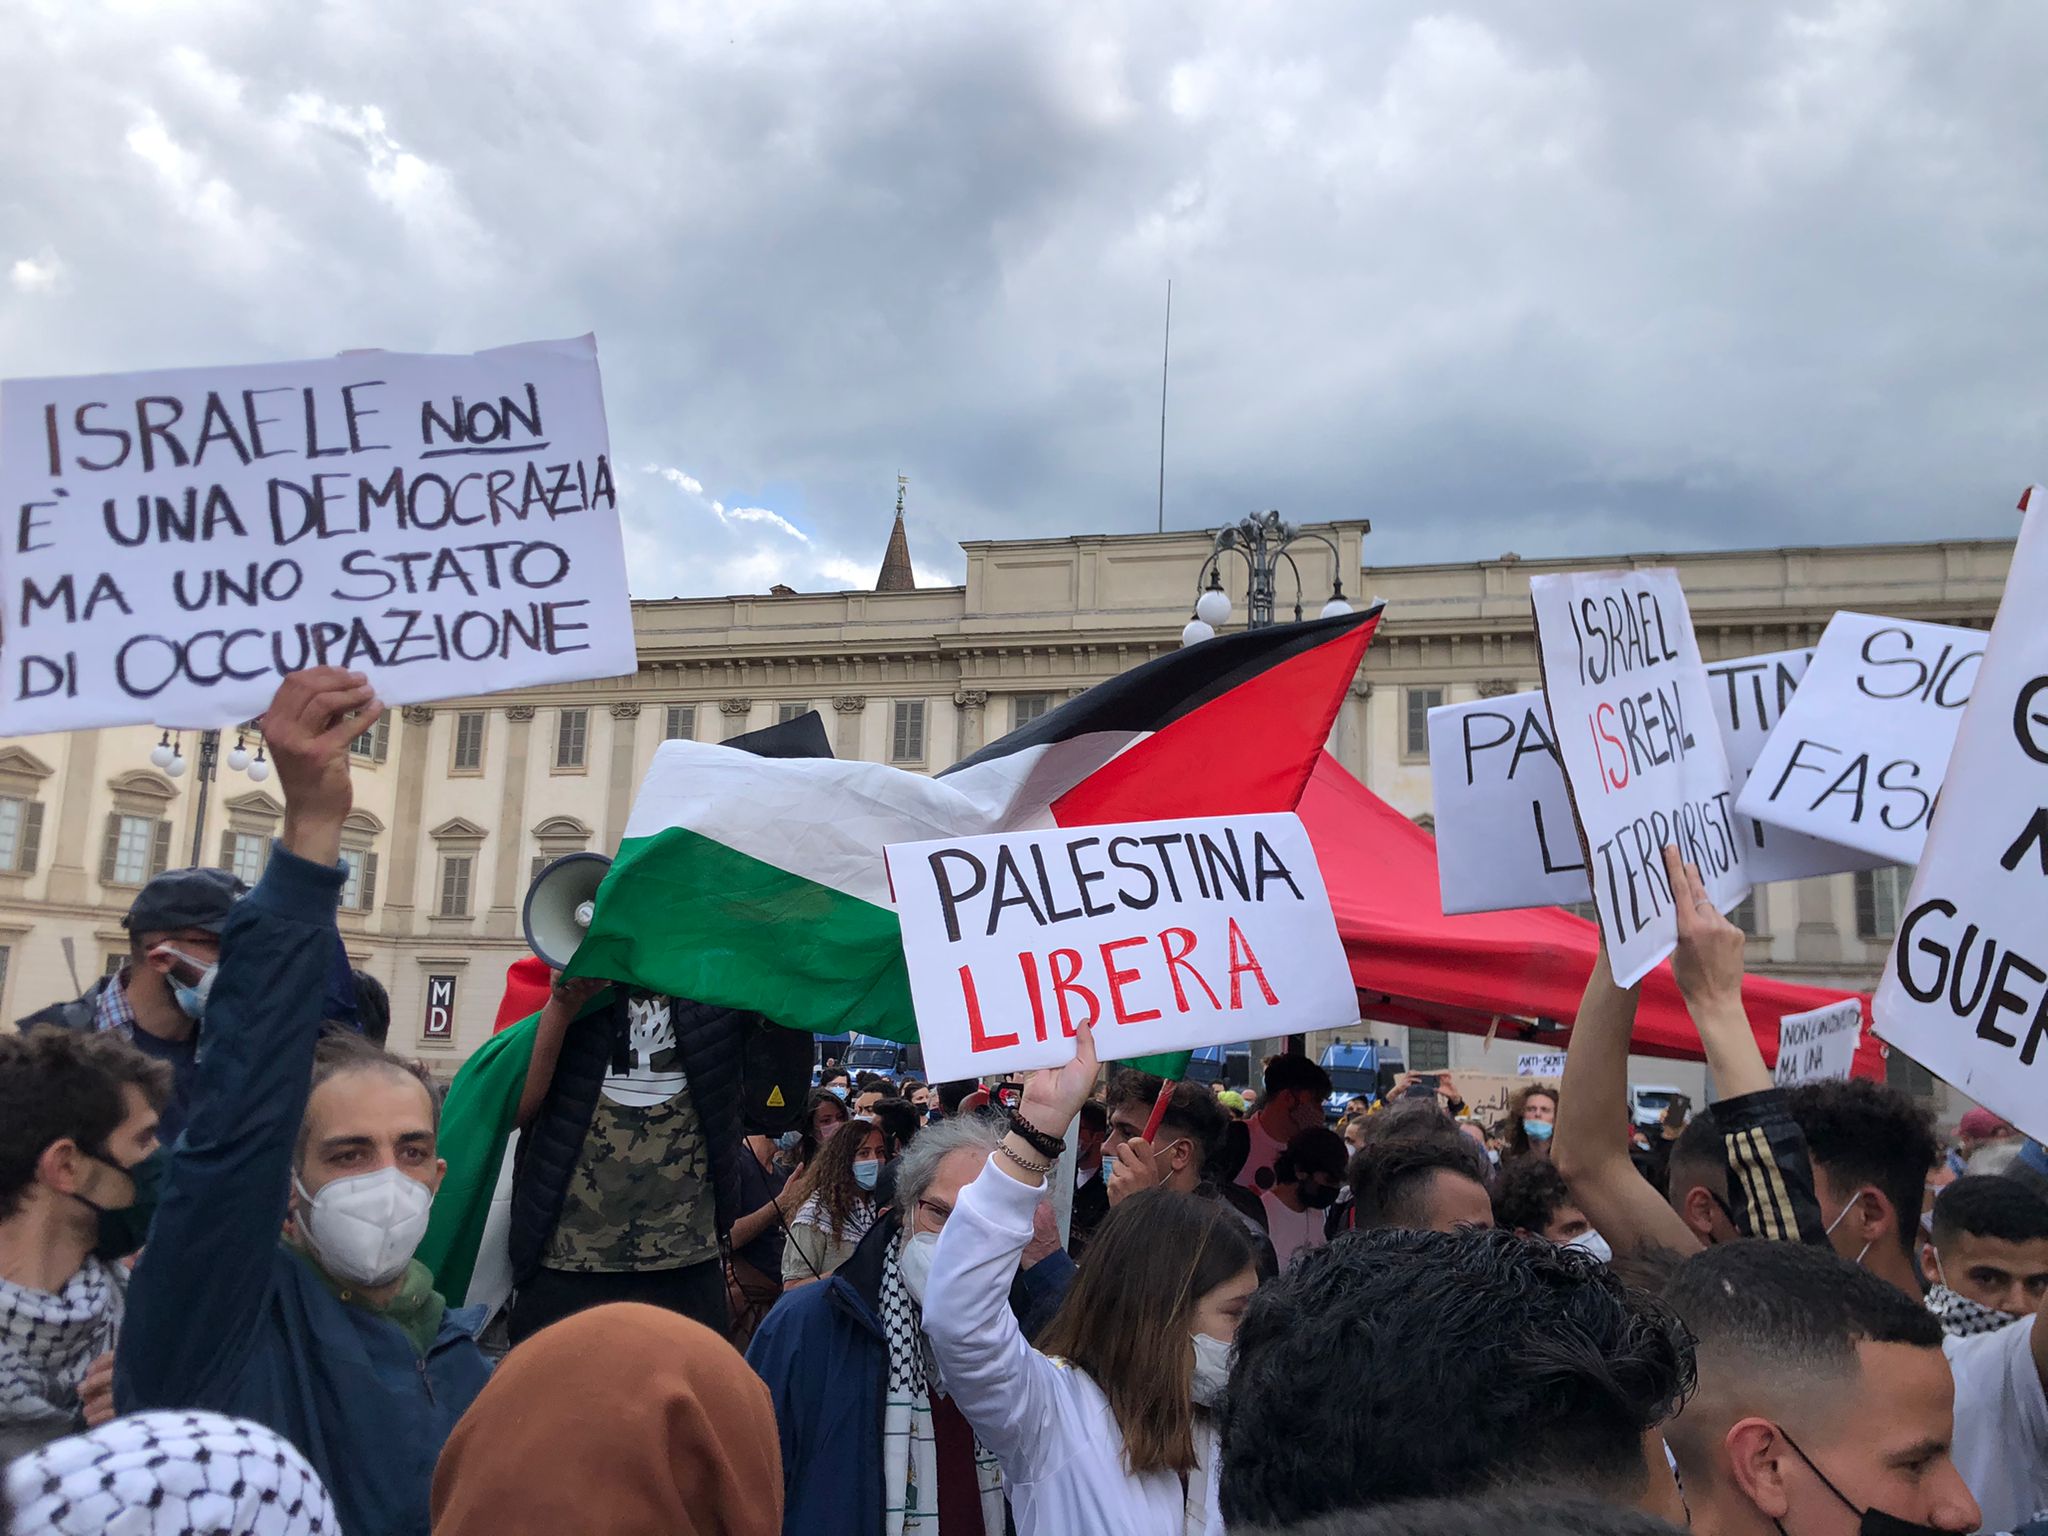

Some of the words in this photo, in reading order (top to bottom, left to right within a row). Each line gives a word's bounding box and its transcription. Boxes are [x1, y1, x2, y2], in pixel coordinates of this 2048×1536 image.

[45, 381, 392, 476] ISRAELE
[421, 383, 545, 447] NON
[18, 487, 70, 553] È
[103, 484, 249, 547] UNA
[268, 455, 617, 546] DEMOCRAZIA
[20, 572, 133, 627] MA
[173, 558, 303, 613] UNO
[331, 541, 571, 601] STATO
[19, 651, 78, 701] DI
[115, 600, 591, 698] OCCUPAZIONE
[1568, 588, 1679, 687] ISRAEL
[1768, 738, 1943, 832] FAS
[928, 828, 1304, 943] PALESTINA
[958, 917, 1280, 1054] LIBERA
